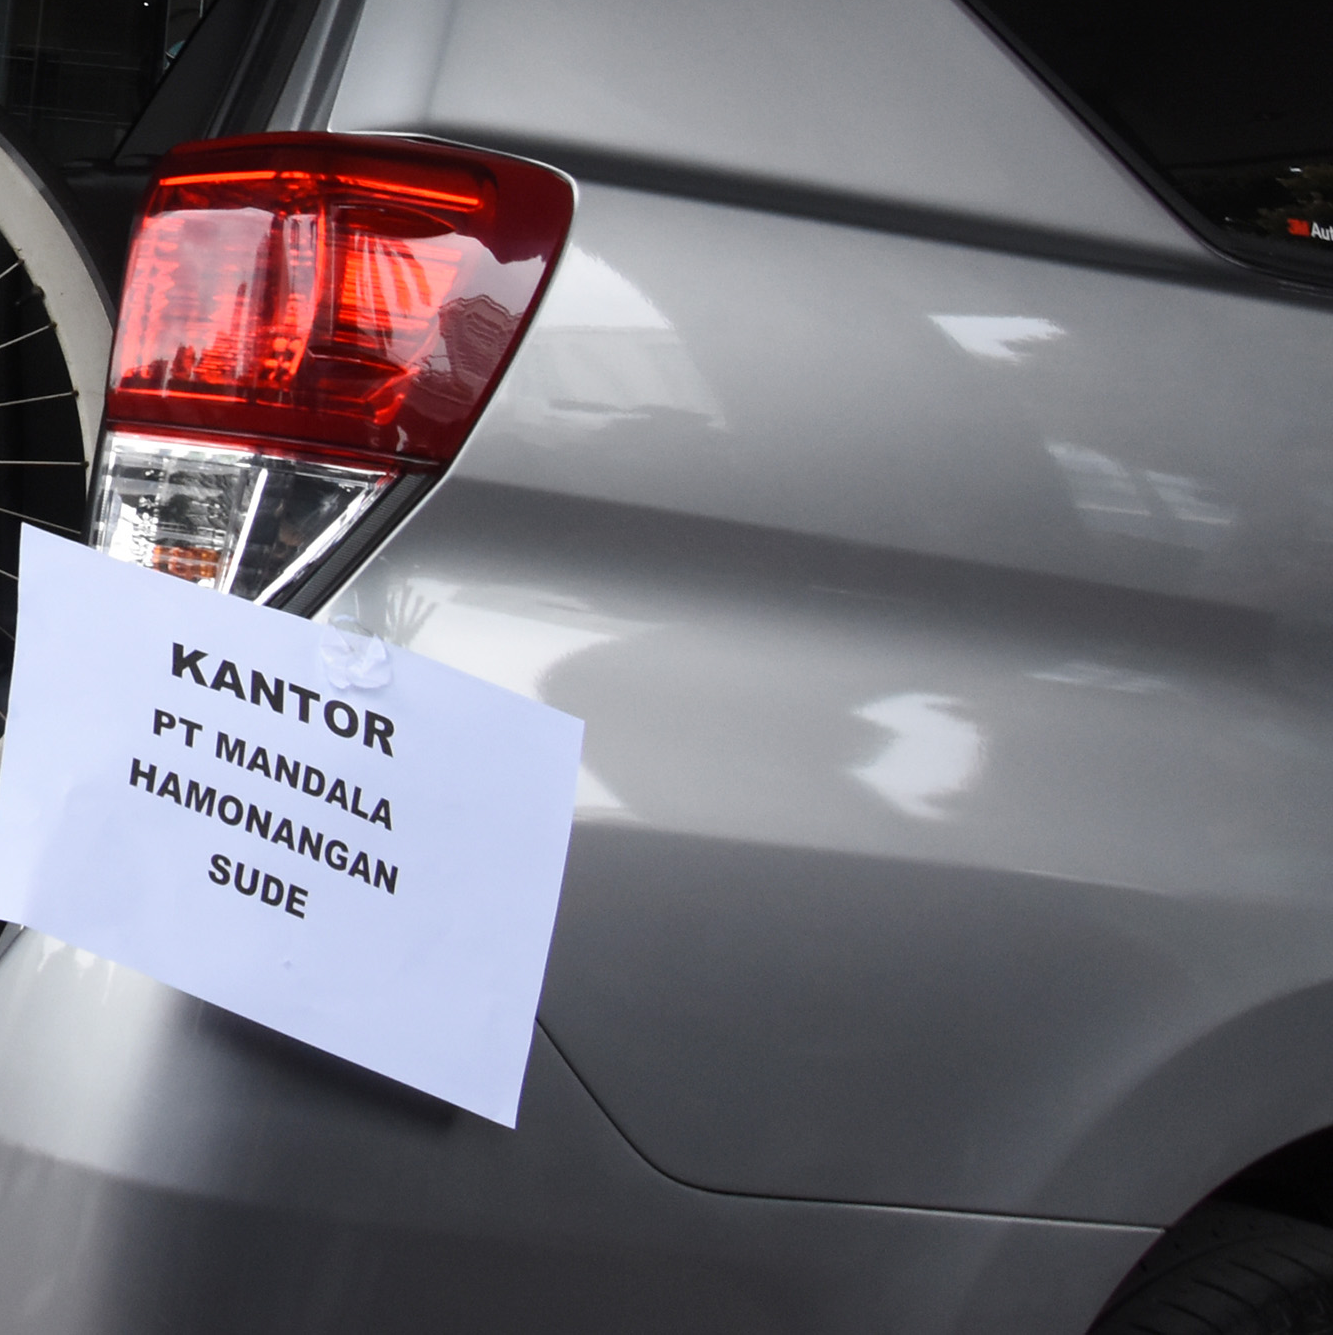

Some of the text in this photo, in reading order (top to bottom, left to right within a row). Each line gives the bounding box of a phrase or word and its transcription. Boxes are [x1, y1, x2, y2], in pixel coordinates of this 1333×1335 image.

[171, 642, 395, 757] KANTOR
[128, 758, 399, 895] HAMONANGAN
[152, 708, 393, 831] PT MANDALA
[207, 853, 309, 919] SUDE
